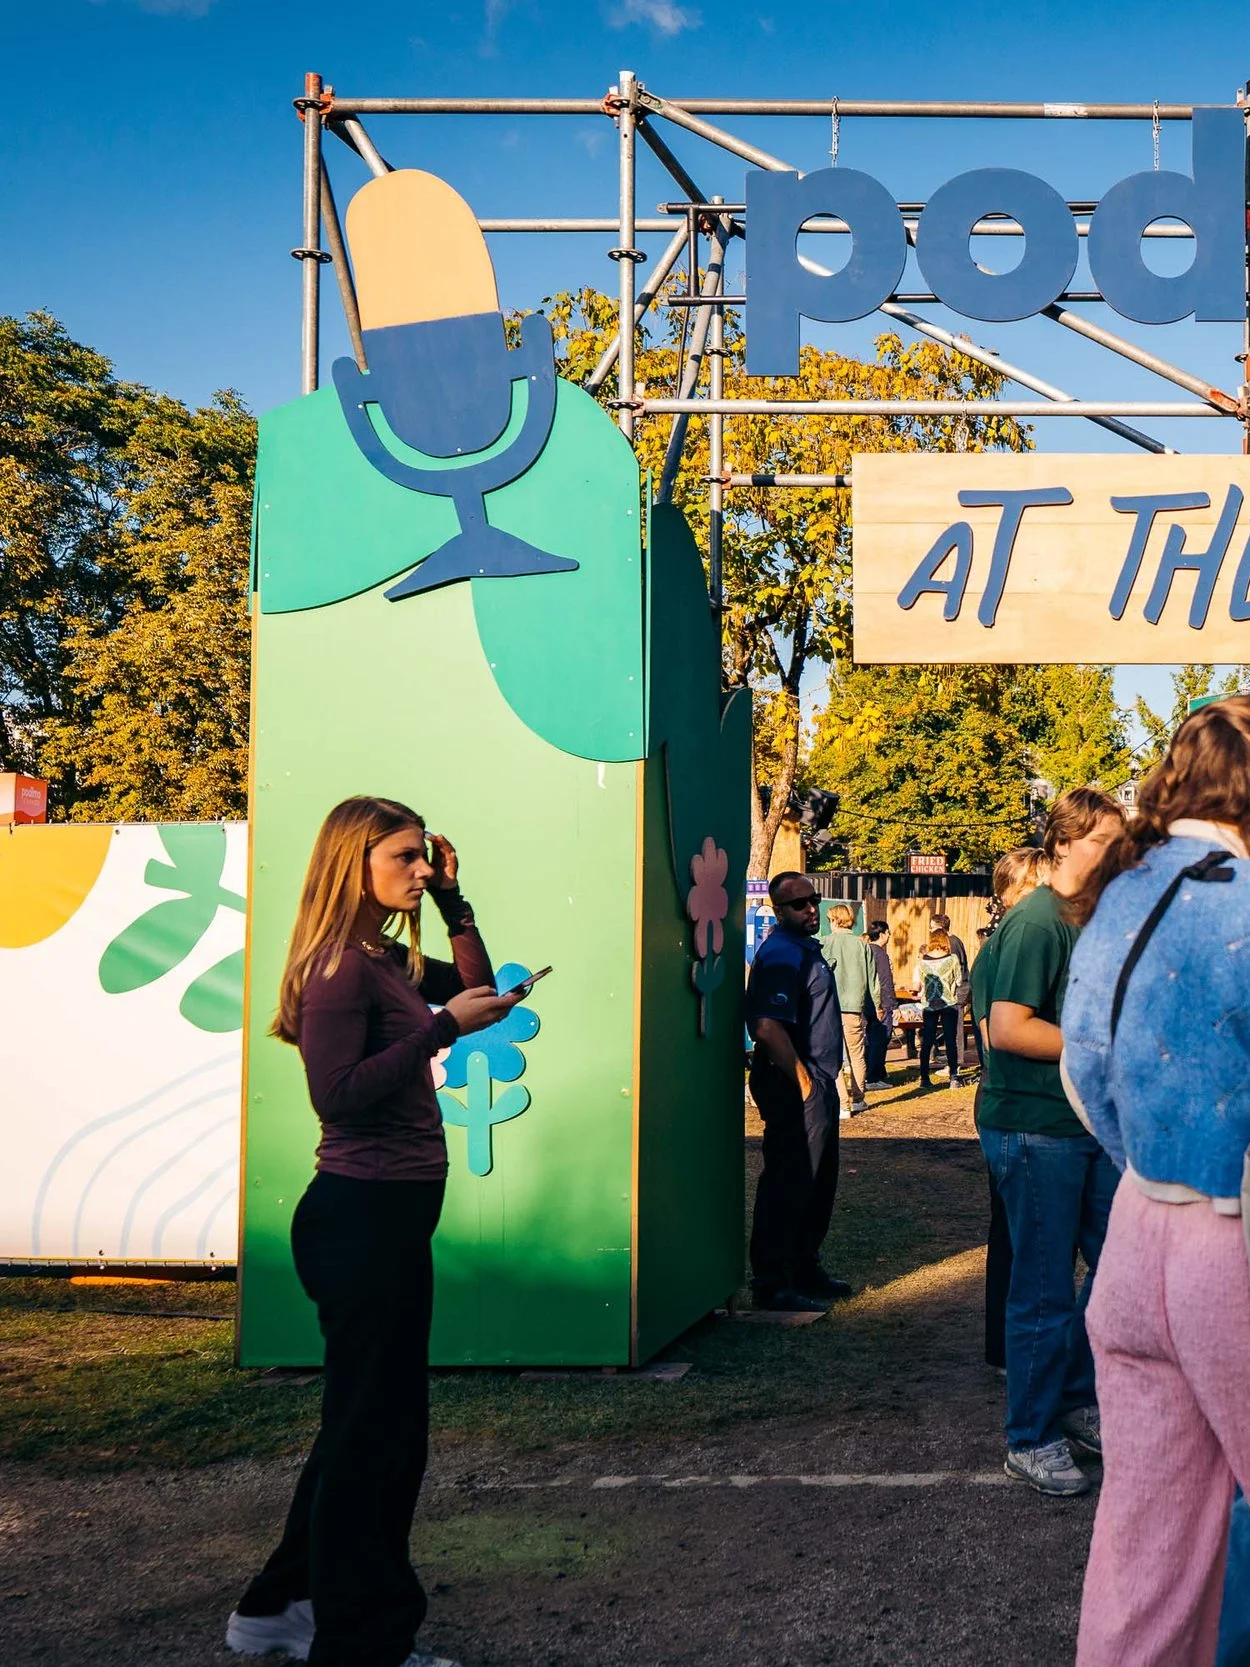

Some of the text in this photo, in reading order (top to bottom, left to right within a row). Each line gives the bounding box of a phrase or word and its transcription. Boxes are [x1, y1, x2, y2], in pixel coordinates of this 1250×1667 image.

[896, 485, 1074, 628] AT
[911, 856, 944, 865] FRIED
[910, 865, 944, 873] CHICKEN
